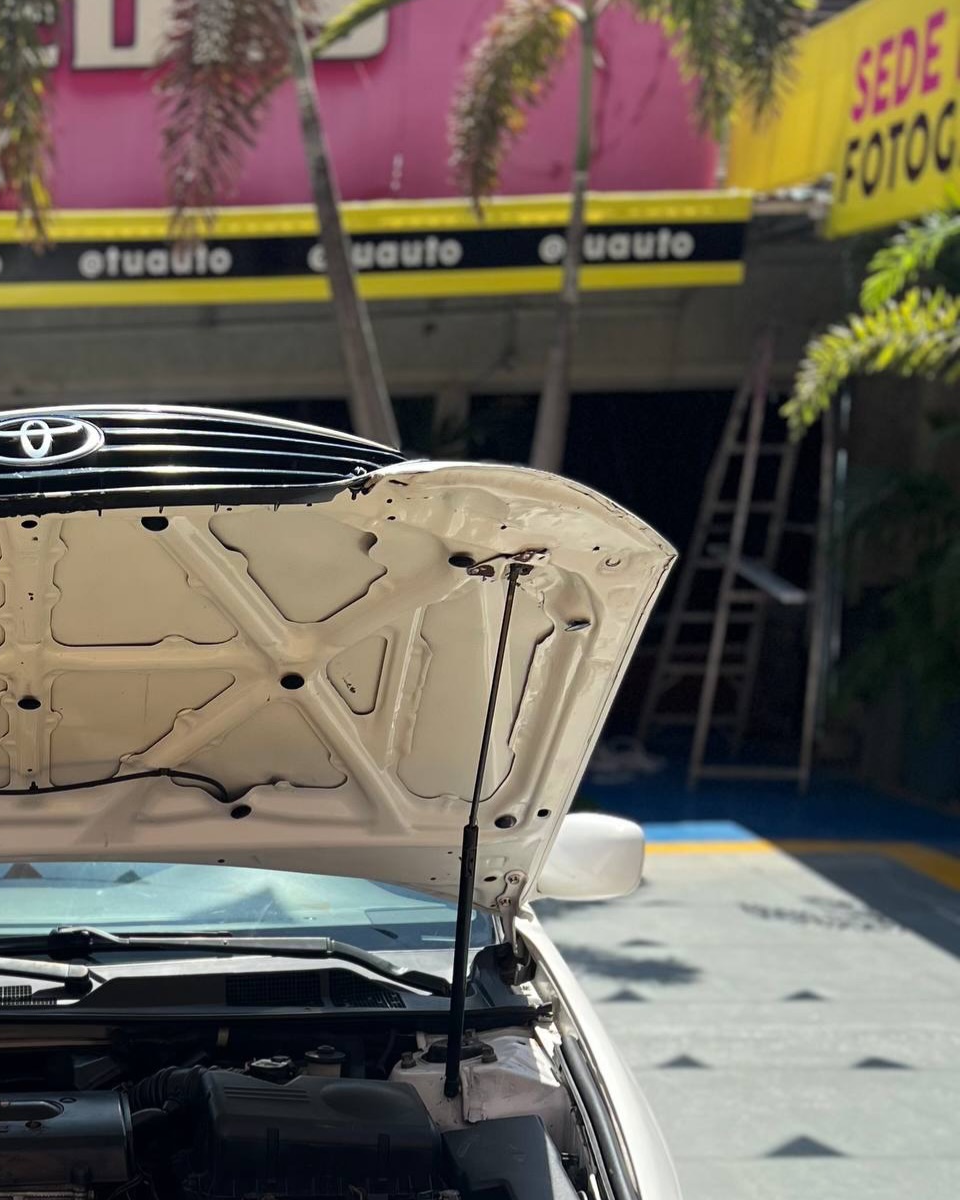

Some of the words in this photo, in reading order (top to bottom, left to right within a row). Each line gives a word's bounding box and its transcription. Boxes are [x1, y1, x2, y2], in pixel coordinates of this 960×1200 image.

[851, 9, 947, 124] SEDE
[839, 100, 960, 203] FOTOG
[78, 242, 232, 279] @tuauto
[307, 235, 463, 272] @uauto
[538, 228, 695, 264] @uauto
